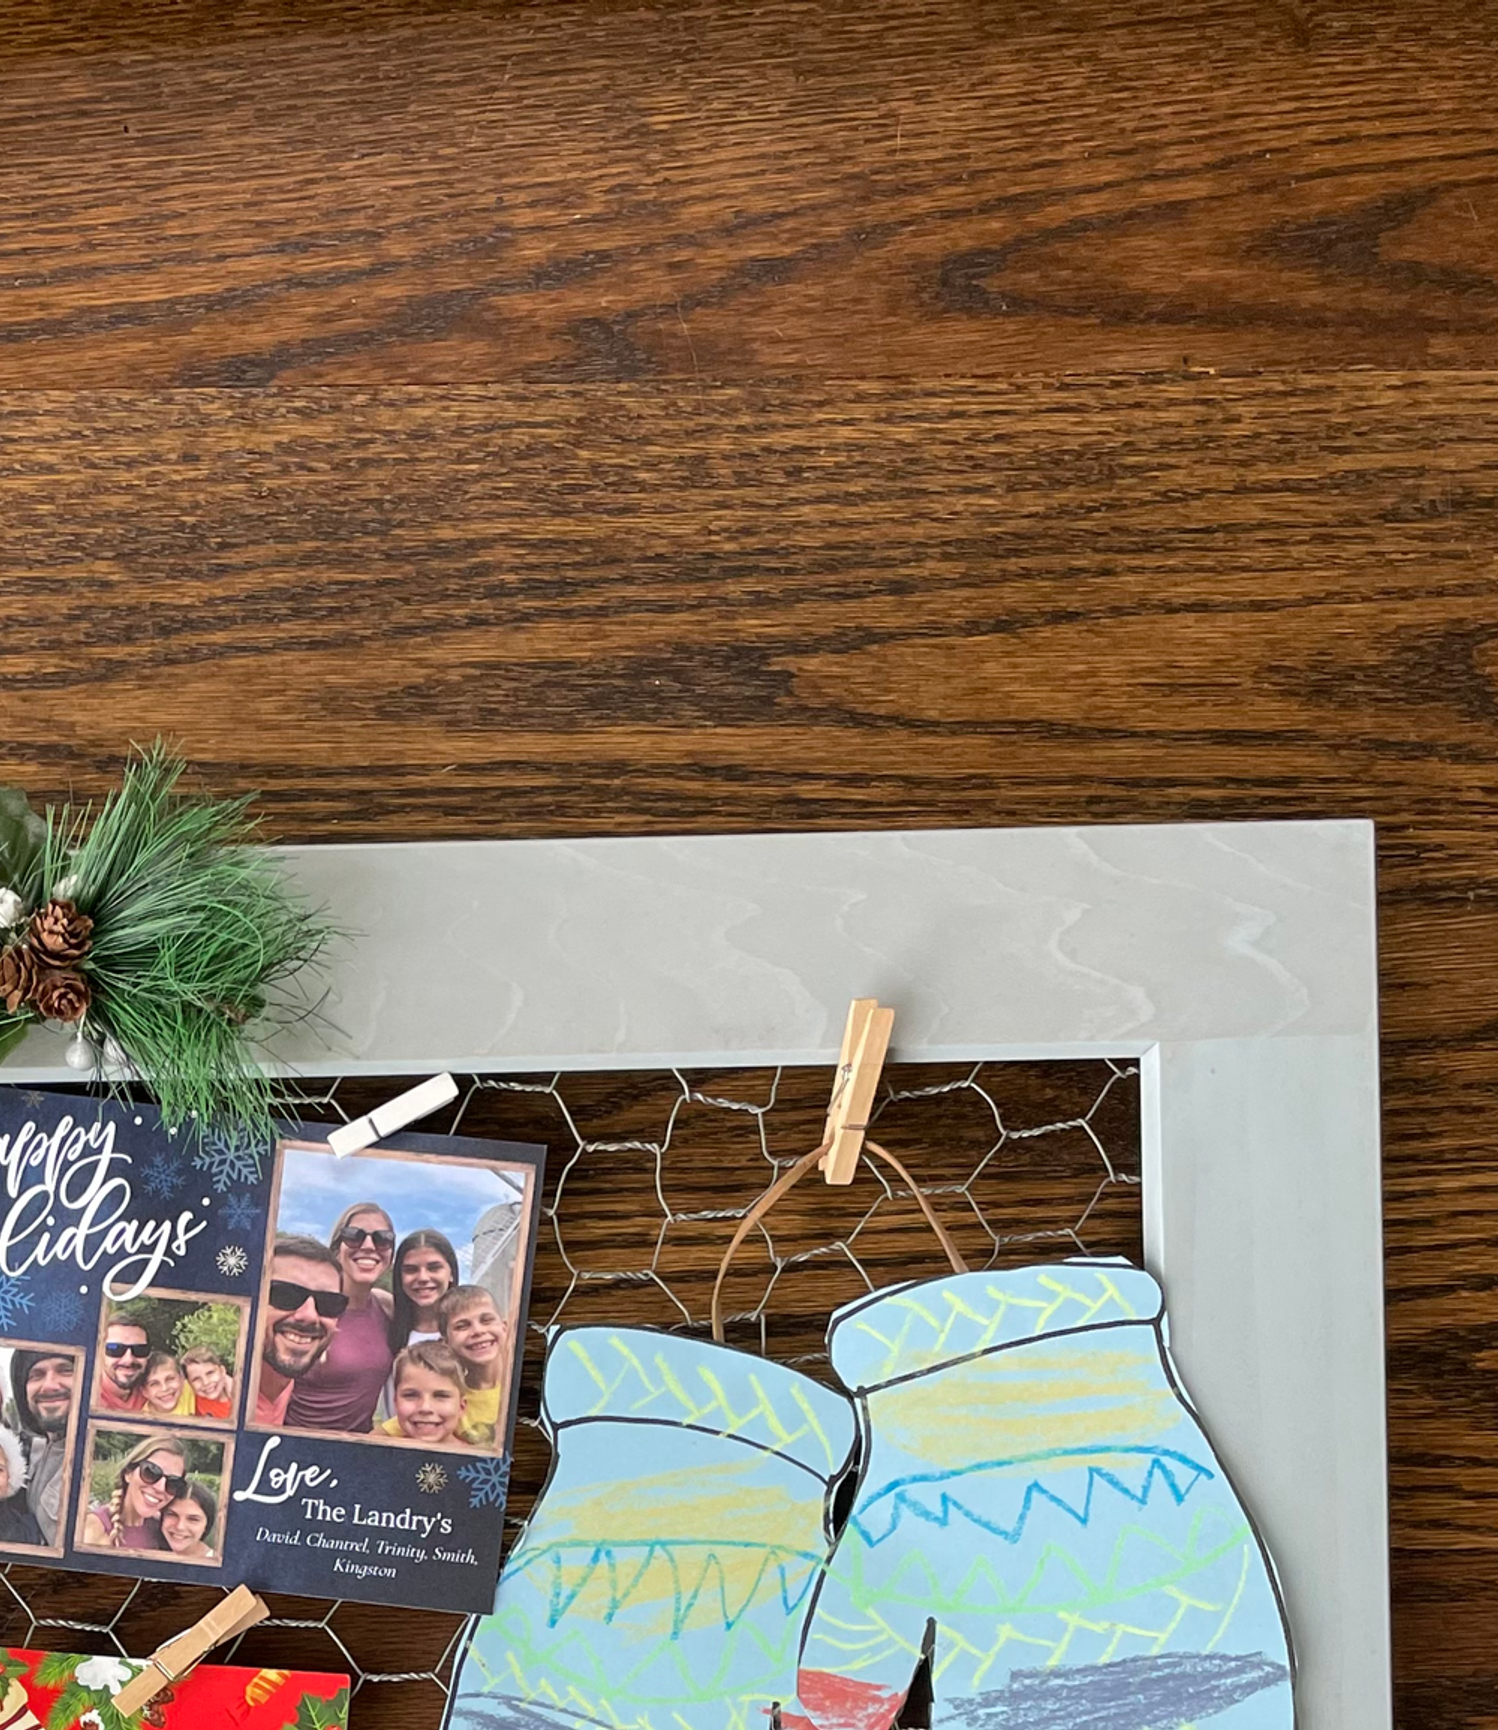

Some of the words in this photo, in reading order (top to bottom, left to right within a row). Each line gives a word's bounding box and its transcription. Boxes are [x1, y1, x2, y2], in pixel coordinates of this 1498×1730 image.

[233, 1435, 339, 1504] Love,
[302, 1498, 346, 1522] The
[352, 1504, 453, 1538] Landry's
[332, 1557, 398, 1579] Kingston
